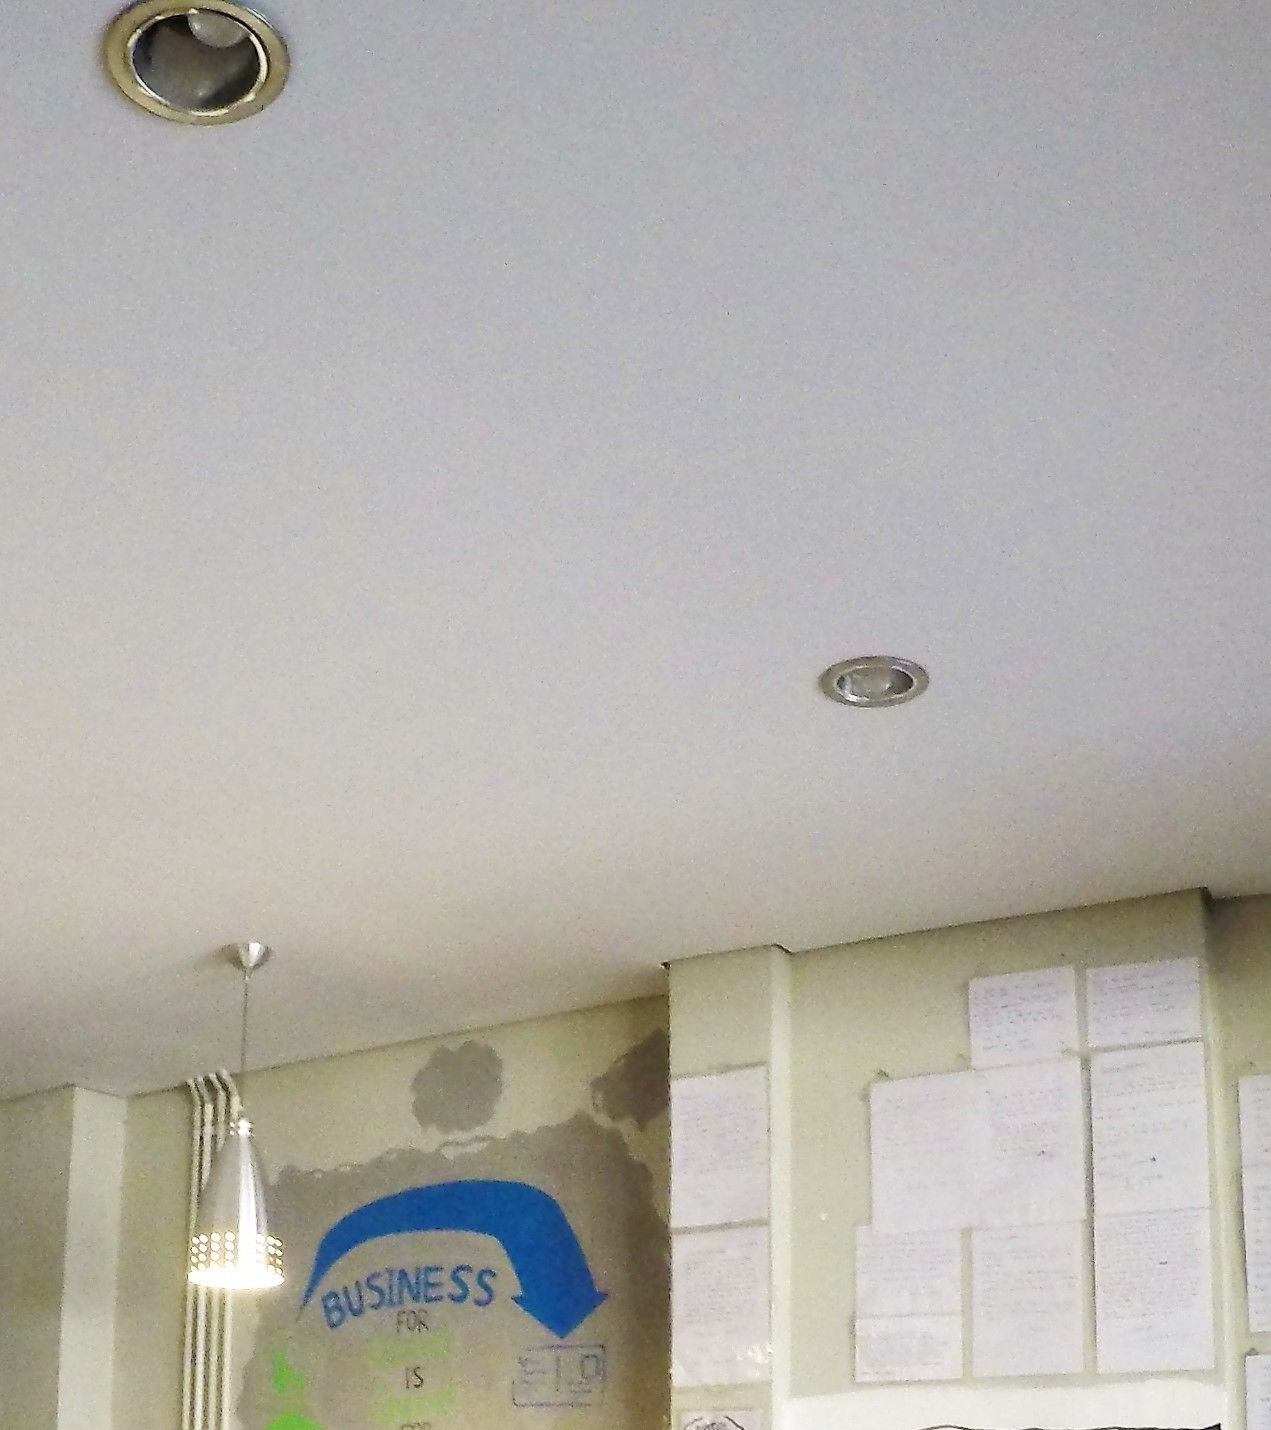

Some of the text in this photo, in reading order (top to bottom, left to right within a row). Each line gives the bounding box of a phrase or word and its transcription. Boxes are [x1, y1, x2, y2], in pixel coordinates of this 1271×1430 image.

[321, 1264, 497, 1329] BUSINESS
[395, 1308, 430, 1333] FOR
[404, 1366, 425, 1390] IS
